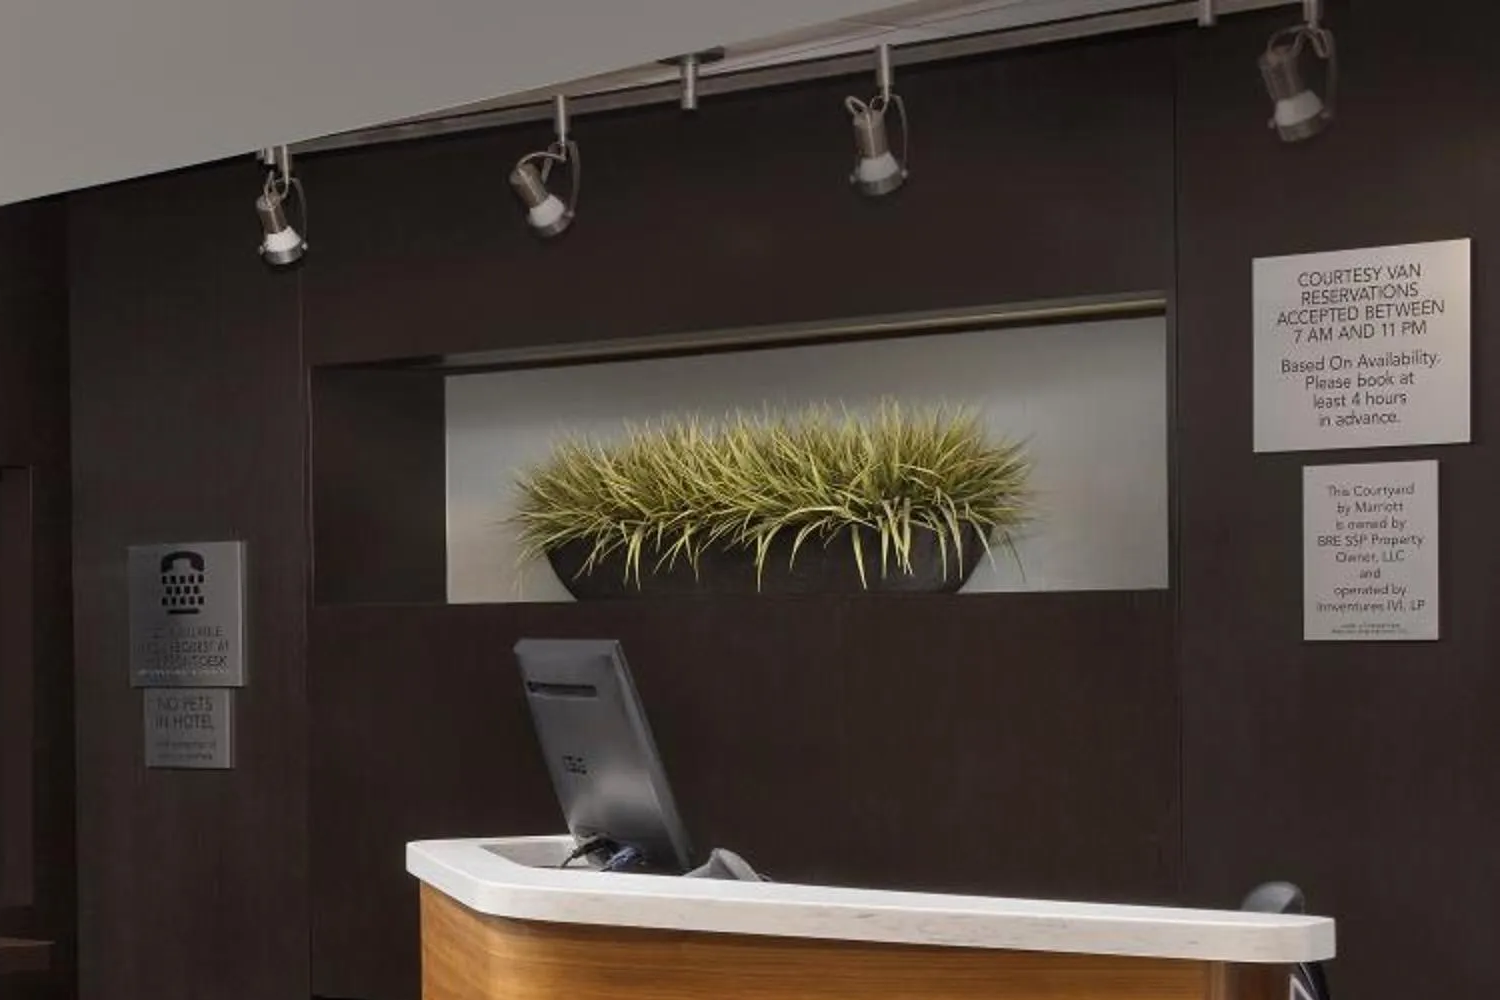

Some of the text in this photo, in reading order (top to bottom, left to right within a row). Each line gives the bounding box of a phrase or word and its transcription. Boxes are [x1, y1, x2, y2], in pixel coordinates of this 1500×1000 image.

[1298, 263, 1421, 287] COURTESY VAN
[1301, 282, 1418, 306] RESERVATIONS
[1277, 300, 1445, 326] ACCEPTED BETWEEN
[1293, 320, 1427, 343] 7 AM AND 11 PM
[1281, 356, 1325, 373] Based
[1329, 355, 1352, 371] On
[1305, 371, 1415, 390] Please book at
[1313, 391, 1407, 409] least 4 hours
[1319, 413, 1332, 427] in
[1353, 482, 1415, 499] Courtyard
[1337, 501, 1404, 516] by Marriott
[1391, 516, 1407, 531] by
[1371, 533, 1424, 549] Property
[1382, 550, 1405, 563] LLC
[1359, 567, 1381, 579] and
[1333, 583, 1407, 598] operated by
[173, 713, 215, 730] HOTEL
